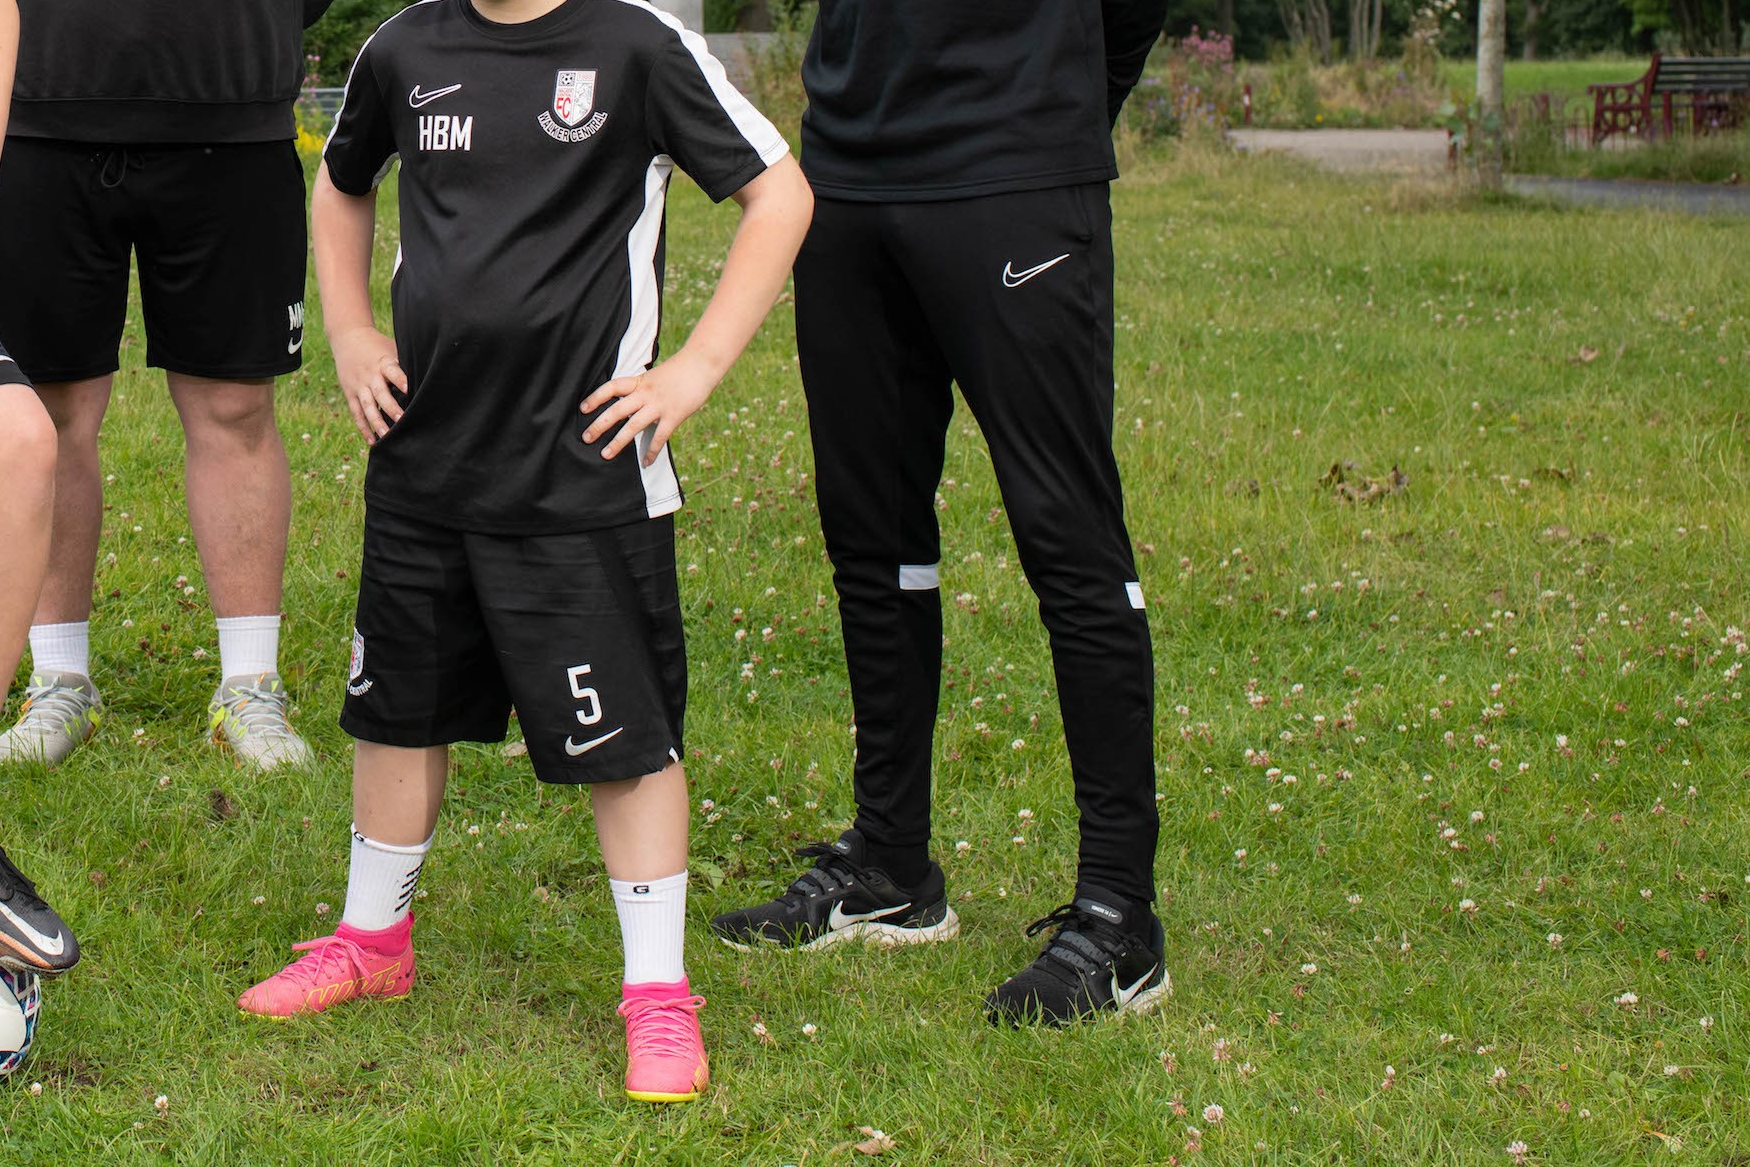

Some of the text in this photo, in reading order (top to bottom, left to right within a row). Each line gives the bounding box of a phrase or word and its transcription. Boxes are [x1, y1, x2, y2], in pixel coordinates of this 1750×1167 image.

[556, 97, 571, 119] FC
[419, 115, 473, 151] HBM
[537, 111, 608, 143] WALKER CENTRAL
[566, 663, 603, 726] 5
[633, 885, 650, 894] G
